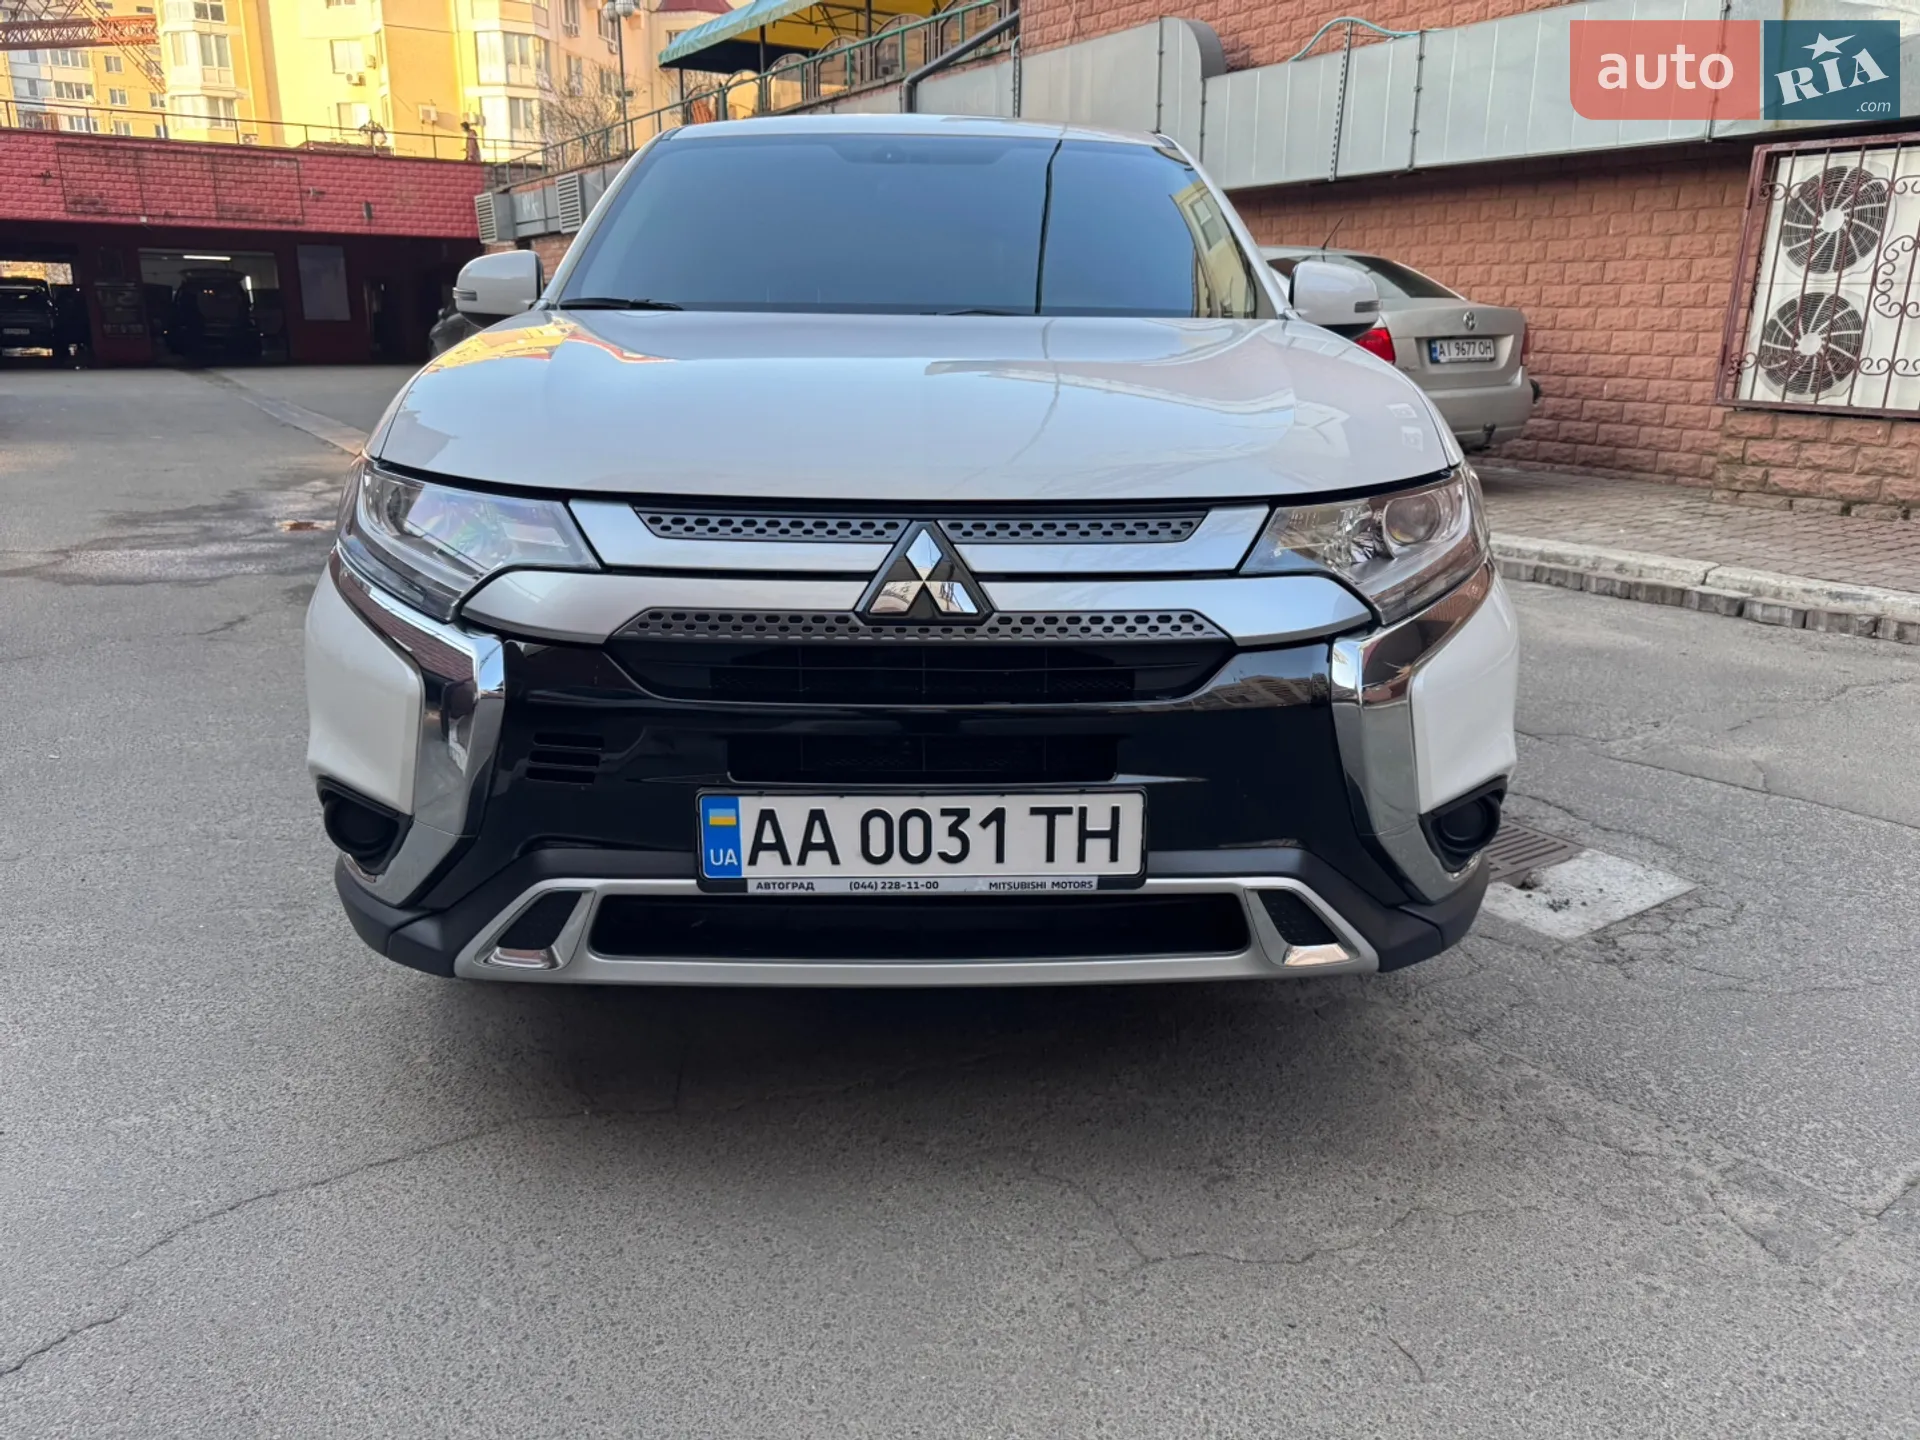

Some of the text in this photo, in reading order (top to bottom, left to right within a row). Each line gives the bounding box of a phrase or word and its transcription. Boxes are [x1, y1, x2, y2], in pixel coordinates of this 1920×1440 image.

[1455, 341, 1476, 356] 9677
[747, 806, 1120, 866] AA 0031 TH
[710, 848, 739, 866] UA
[756, 882, 815, 891] АВТОГРАД
[849, 881, 939, 891] (044) 228-11-00
[989, 880, 1094, 890] MITSUBISHI MOTORS
